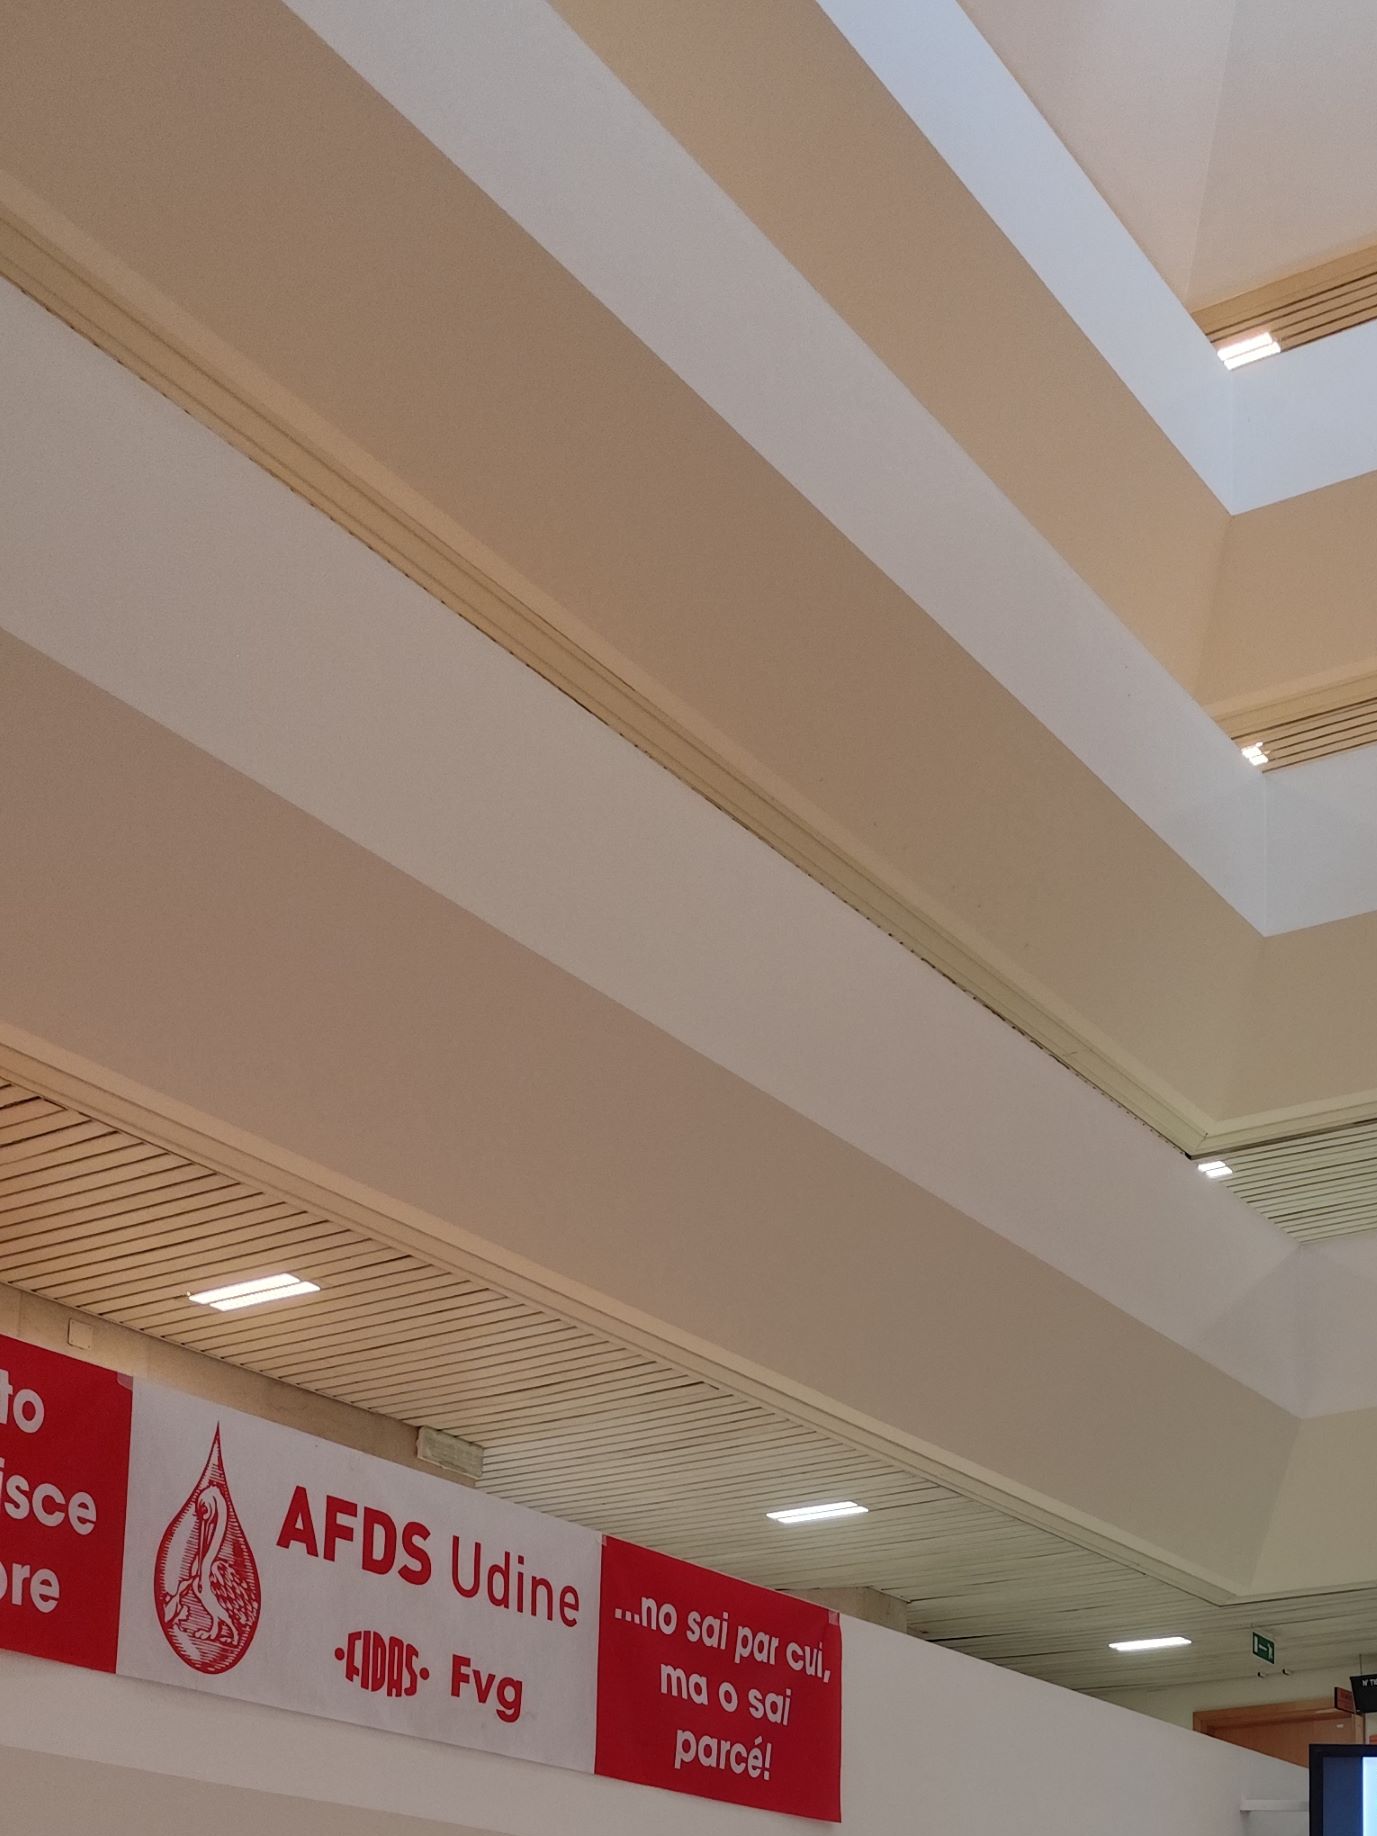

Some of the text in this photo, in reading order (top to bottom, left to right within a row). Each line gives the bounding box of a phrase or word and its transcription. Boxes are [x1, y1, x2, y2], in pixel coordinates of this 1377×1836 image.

[0, 1560, 60, 1614] re
[276, 1485, 580, 1628] AFDS Udine
[686, 1611, 729, 1650] sai
[734, 1625, 779, 1665] par
[785, 1641, 831, 1684] cui,
[450, 1654, 523, 1723] Fvg
[660, 1663, 792, 1726] ma o sai
[674, 1729, 772, 1781] parcé!
